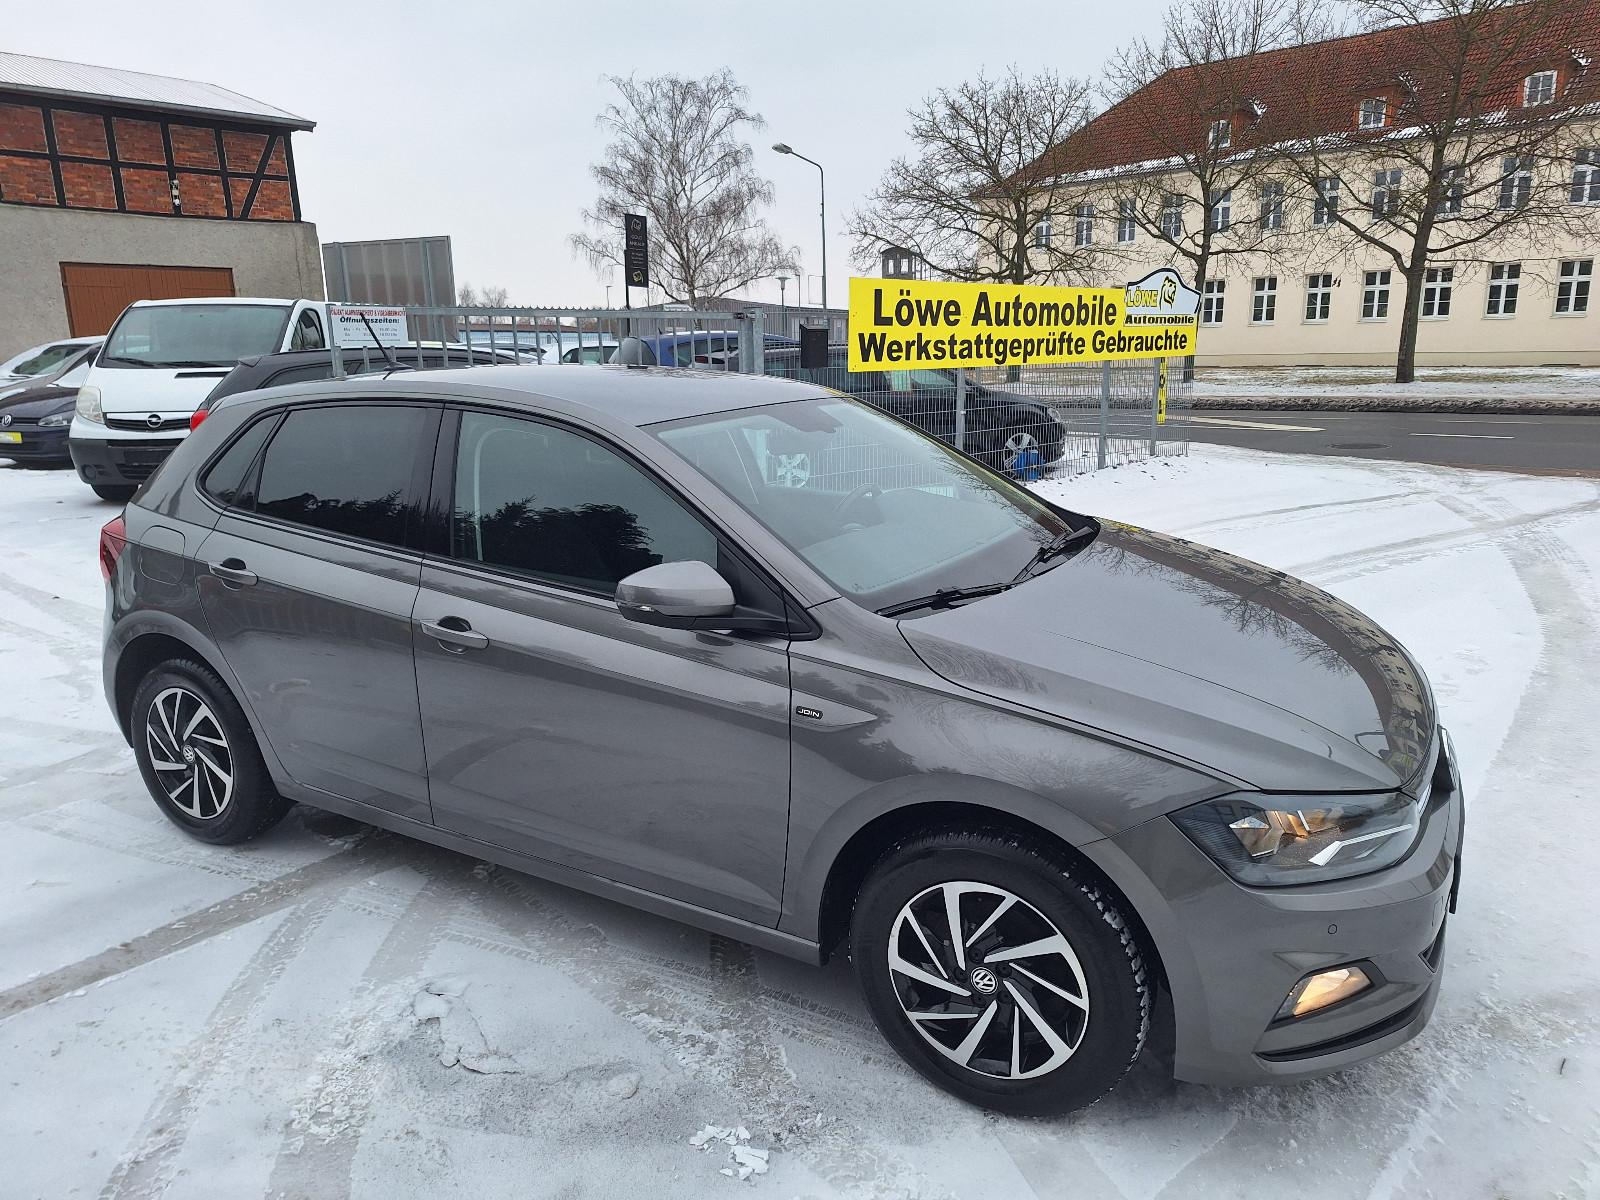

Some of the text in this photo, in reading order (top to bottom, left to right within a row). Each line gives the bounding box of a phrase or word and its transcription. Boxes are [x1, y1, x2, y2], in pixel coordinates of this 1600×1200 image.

[873, 288, 1117, 327] Löwe Automobile
[1126, 287, 1159, 308] LÖWE
[1125, 314, 1195, 325] Automobile
[858, 329, 1188, 365] Werkstattgeprüfte Gebrauchte
[797, 708, 820, 718] JOIN
